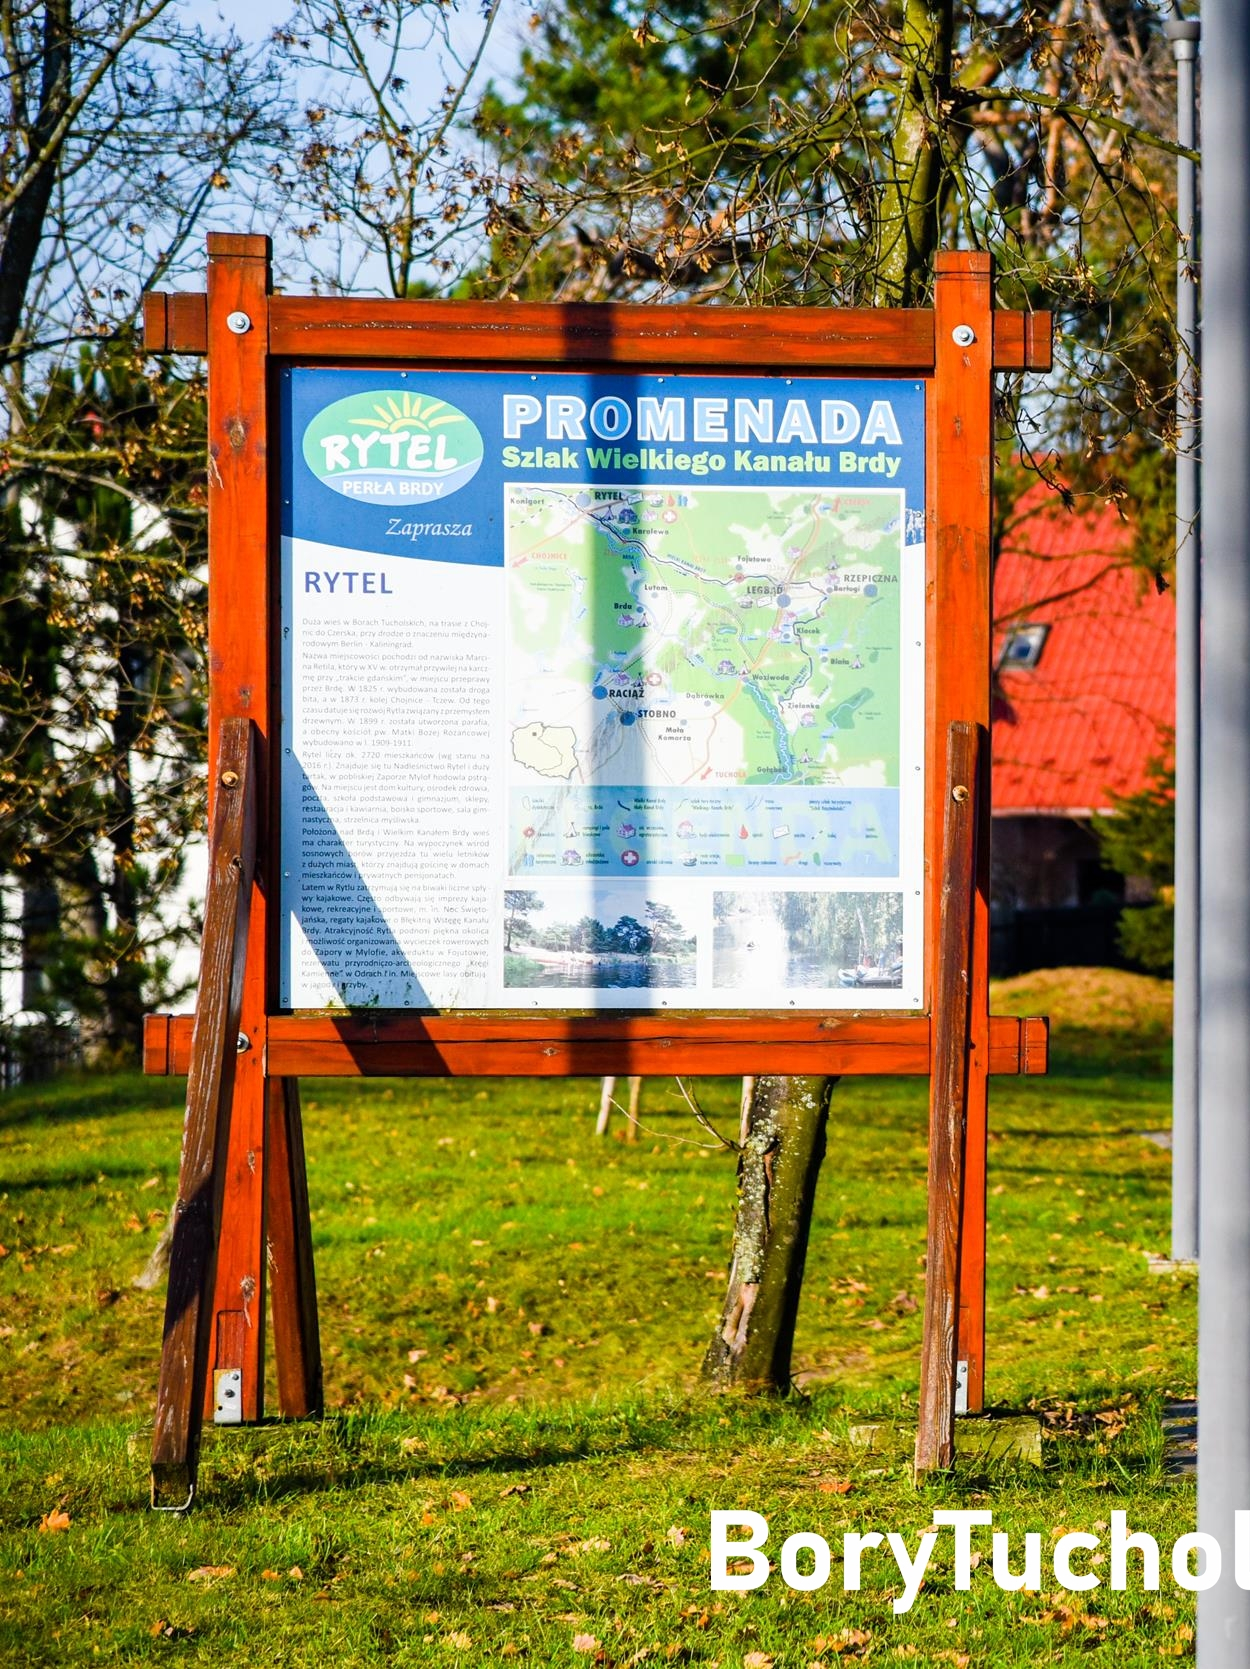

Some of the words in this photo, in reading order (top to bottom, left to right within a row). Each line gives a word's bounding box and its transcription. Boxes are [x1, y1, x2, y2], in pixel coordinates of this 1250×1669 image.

[503, 395, 902, 444] PROMENADA
[320, 431, 458, 472] RYTEL
[502, 447, 578, 470] Szlak
[586, 448, 725, 474] Wielkiego
[733, 450, 832, 474] Kanału
[839, 452, 902, 478] Brdy
[342, 480, 395, 496] PERŁA
[398, 481, 444, 496] BRDY
[594, 492, 624, 501] RYTEL
[385, 518, 473, 542] Zaprasza
[737, 555, 772, 564] Fojutowo
[304, 571, 393, 594] RYTEL
[844, 574, 898, 583] RZEPICZNA
[609, 687, 644, 699] RACIĄŻ
[638, 710, 676, 718] STOBNO
